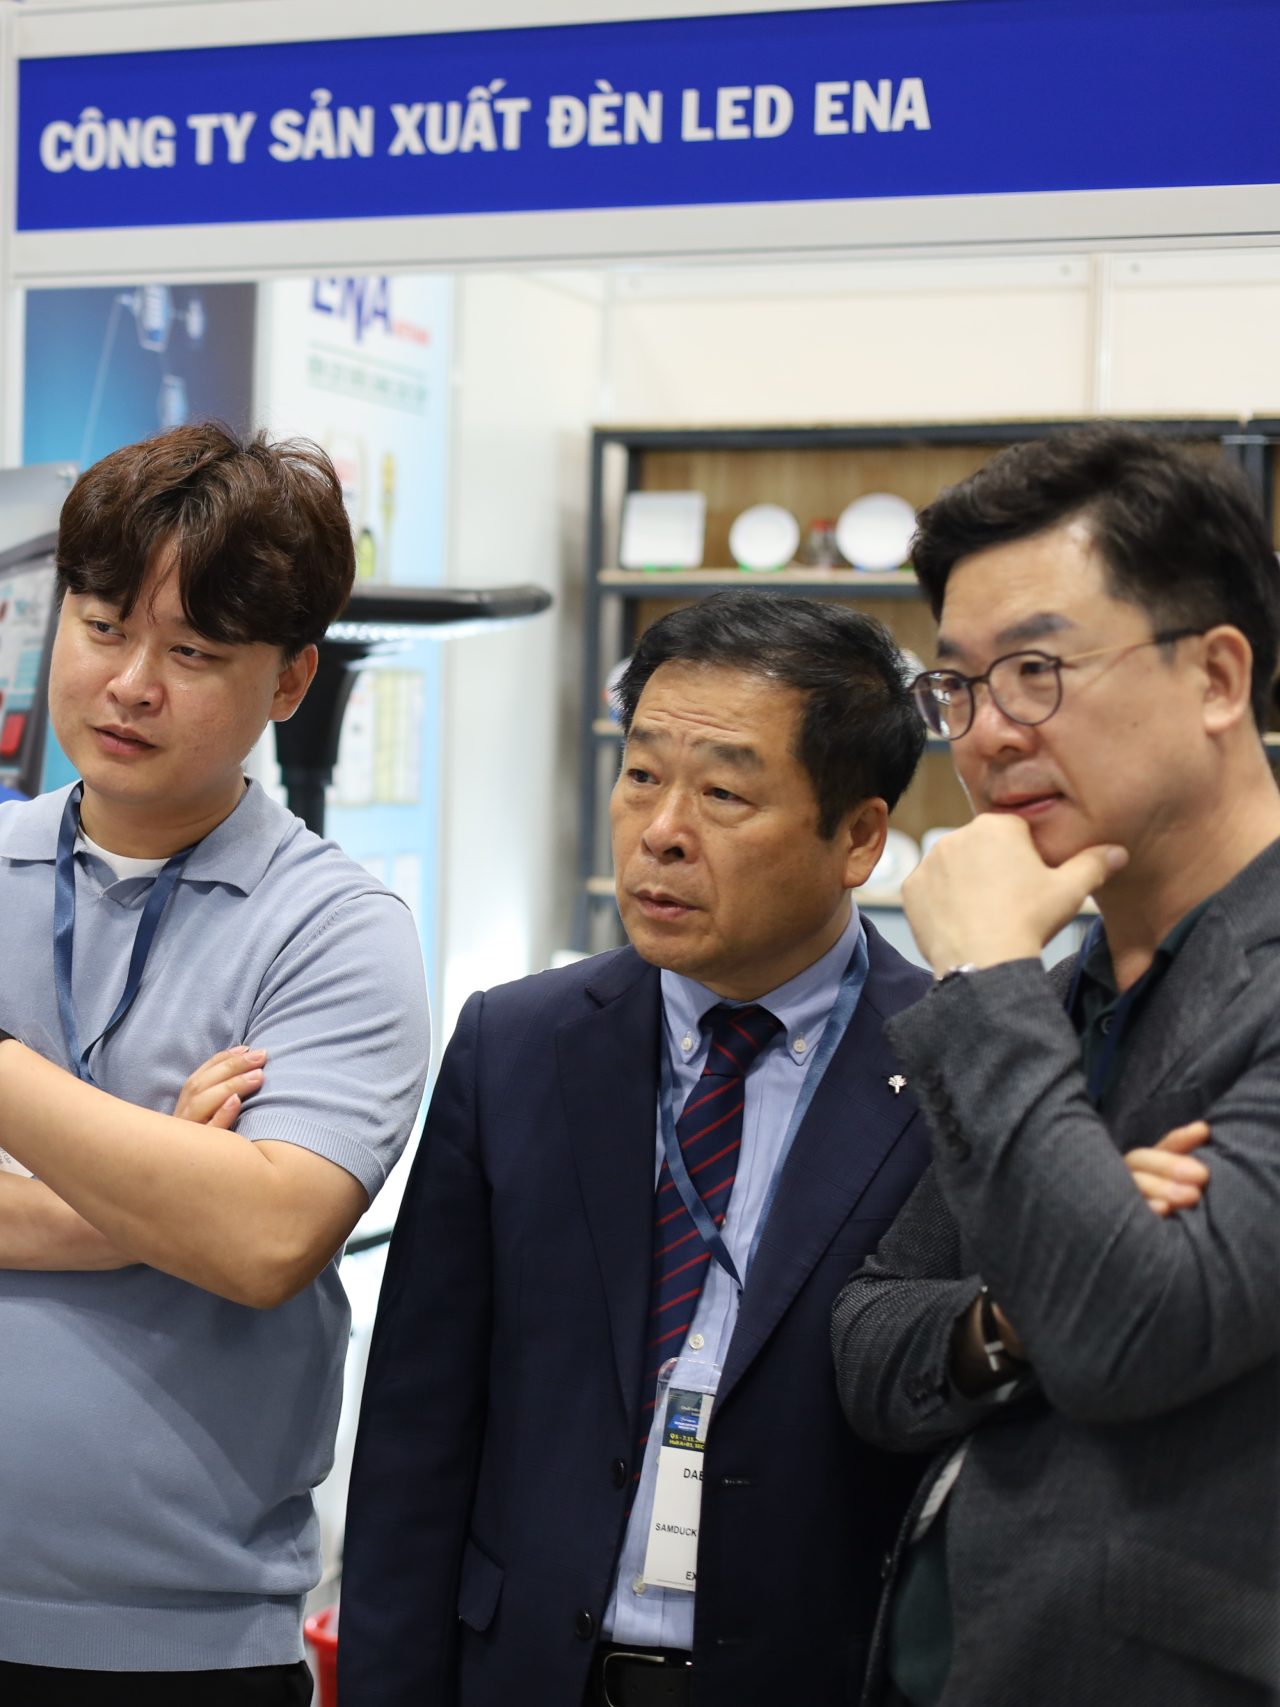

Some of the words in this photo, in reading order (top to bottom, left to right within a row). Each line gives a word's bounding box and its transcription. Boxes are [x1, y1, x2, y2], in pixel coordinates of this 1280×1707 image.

[40, 107, 176, 172] CÔNG
[187, 112, 256, 165] TY
[269, 89, 374, 161] SẢN
[389, 77, 531, 156] XUẤT
[547, 79, 663, 148] ĐÈN
[681, 85, 794, 142] LED
[814, 77, 931, 135] ENA
[655, 1522, 698, 1537] SAMDUCK
